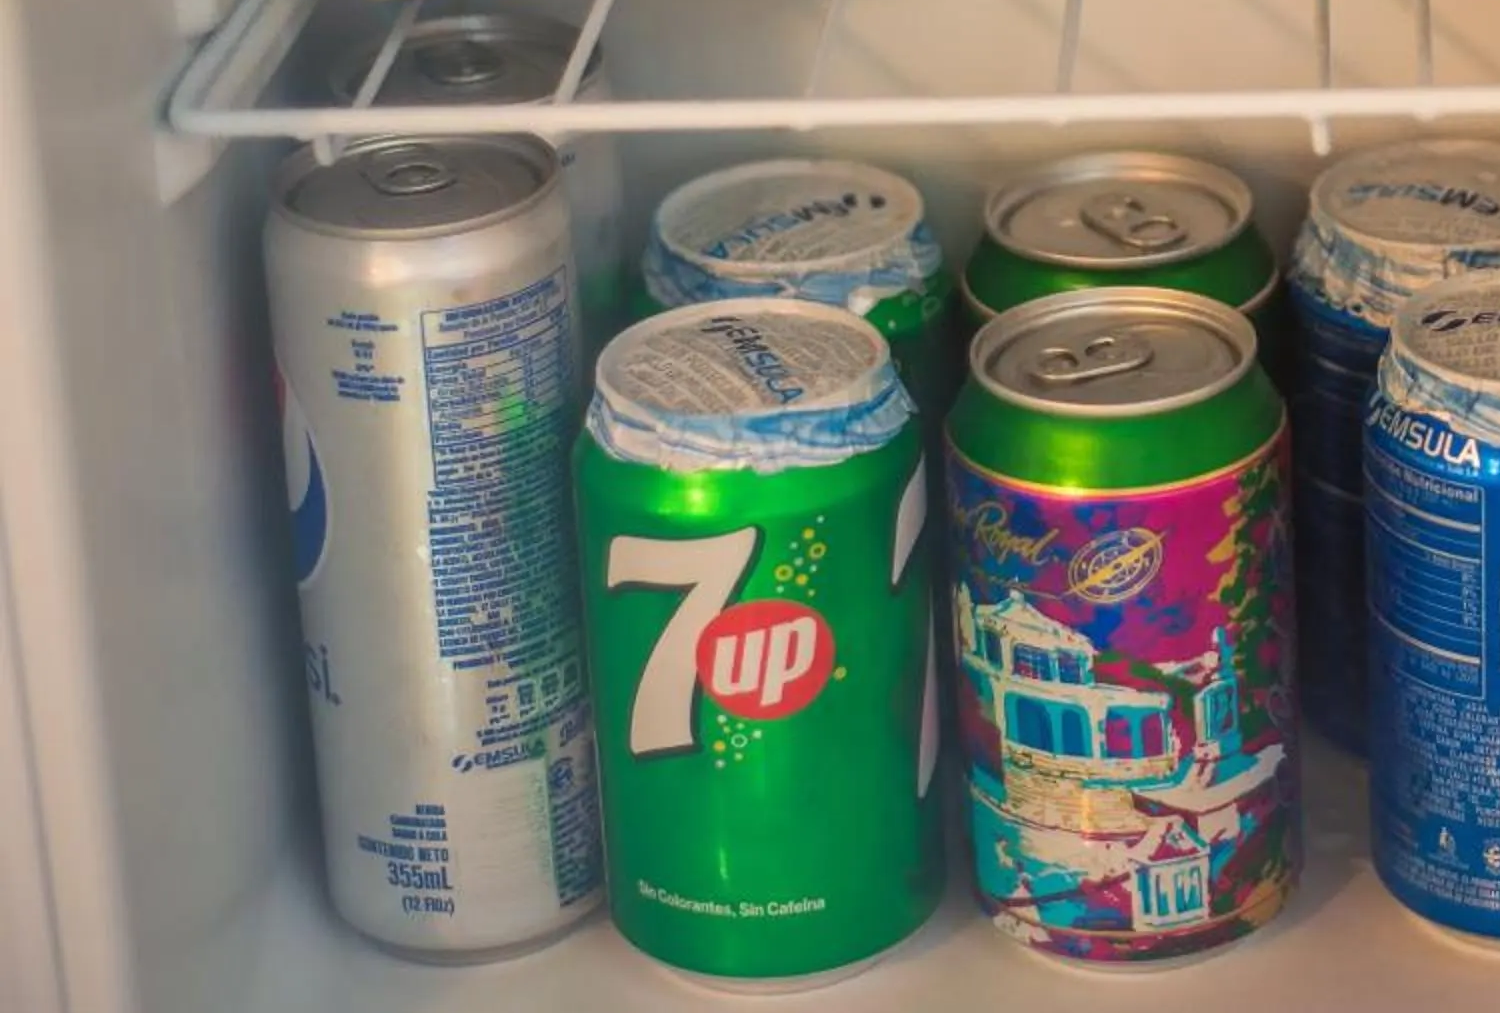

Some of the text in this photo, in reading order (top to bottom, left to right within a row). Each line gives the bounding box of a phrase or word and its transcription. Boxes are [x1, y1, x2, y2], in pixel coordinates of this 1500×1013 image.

[727, 326, 805, 404] EMSULA
[1380, 404, 1482, 469] EMSULA
[386, 860, 453, 890] 355mL
[739, 901, 765, 918] Sin
